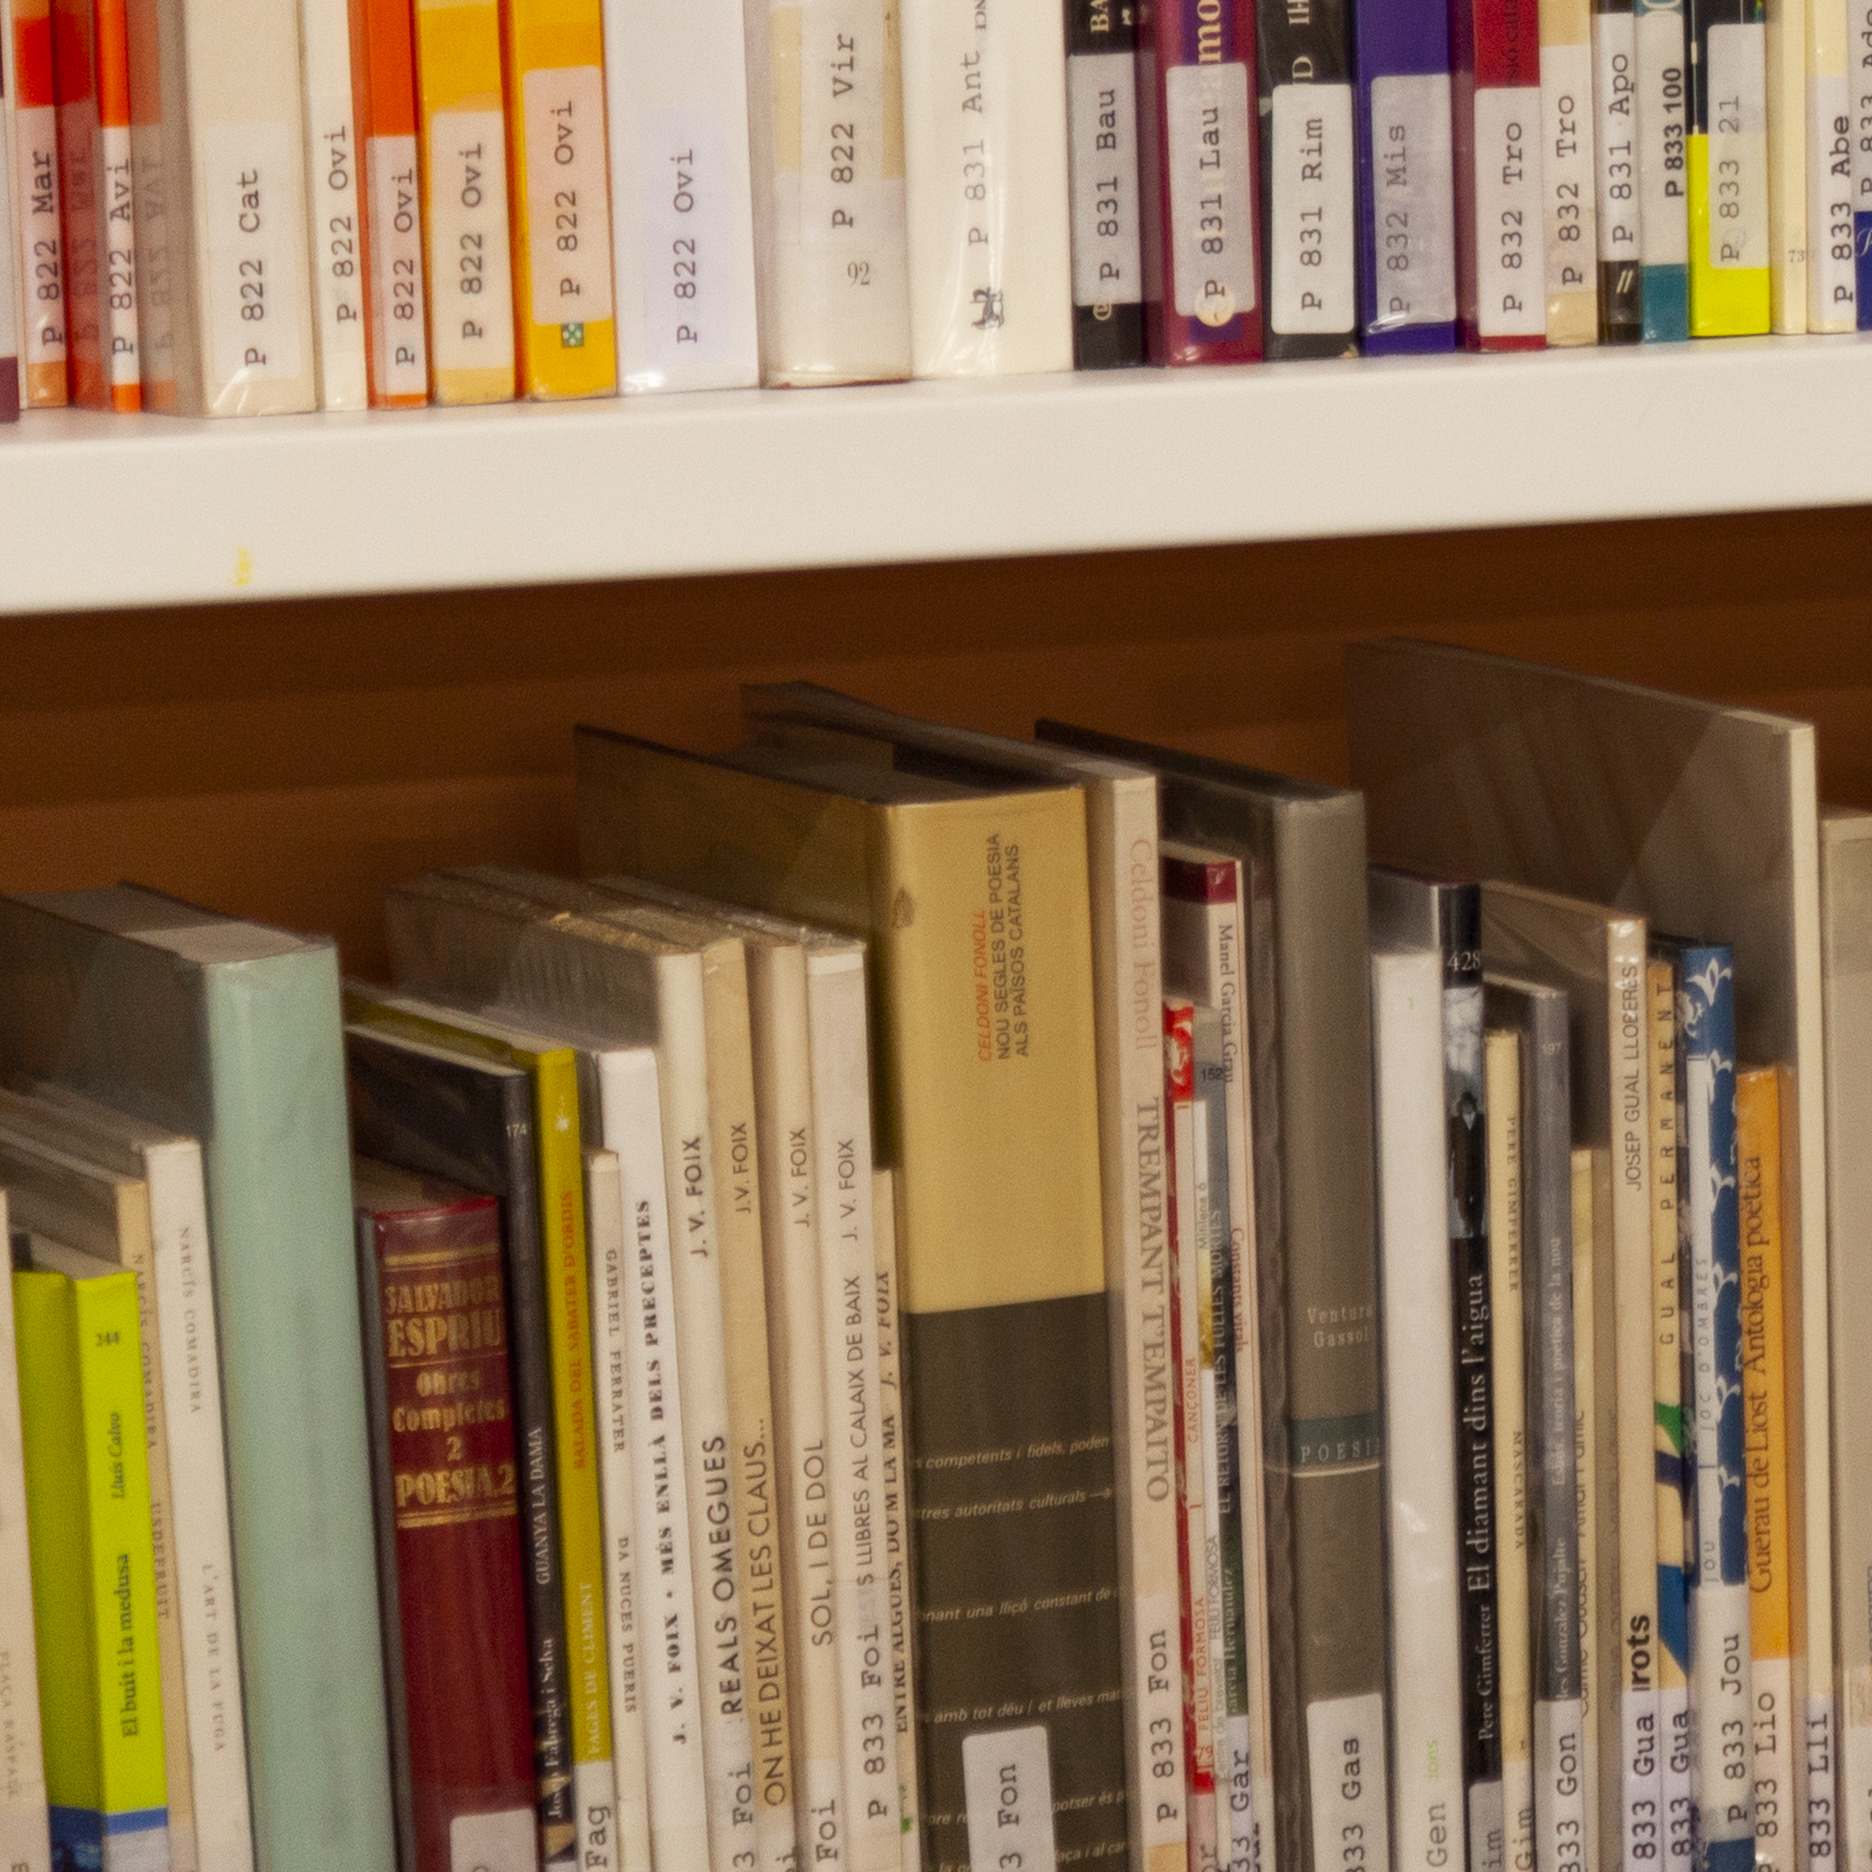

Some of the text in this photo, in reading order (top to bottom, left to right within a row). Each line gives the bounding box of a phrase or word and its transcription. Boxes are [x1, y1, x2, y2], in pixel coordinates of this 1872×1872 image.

[1663, 69, 1683, 197] P 833 100
[551, 100, 580, 296] P 822 Ovi
[1300, 118, 1323, 309] P 831 Rim
[681, 1136, 704, 1197] FOIX
[687, 1208, 705, 1229] V.
[703, 1435, 736, 1600] OMEGUES
[802, 1440, 827, 1500] DOL
[807, 1513, 829, 1552] DE
[811, 1579, 835, 1646] SOL,
[713, 1616, 742, 1714] REALS
[1146, 1630, 1177, 1821] P 833 Fon
